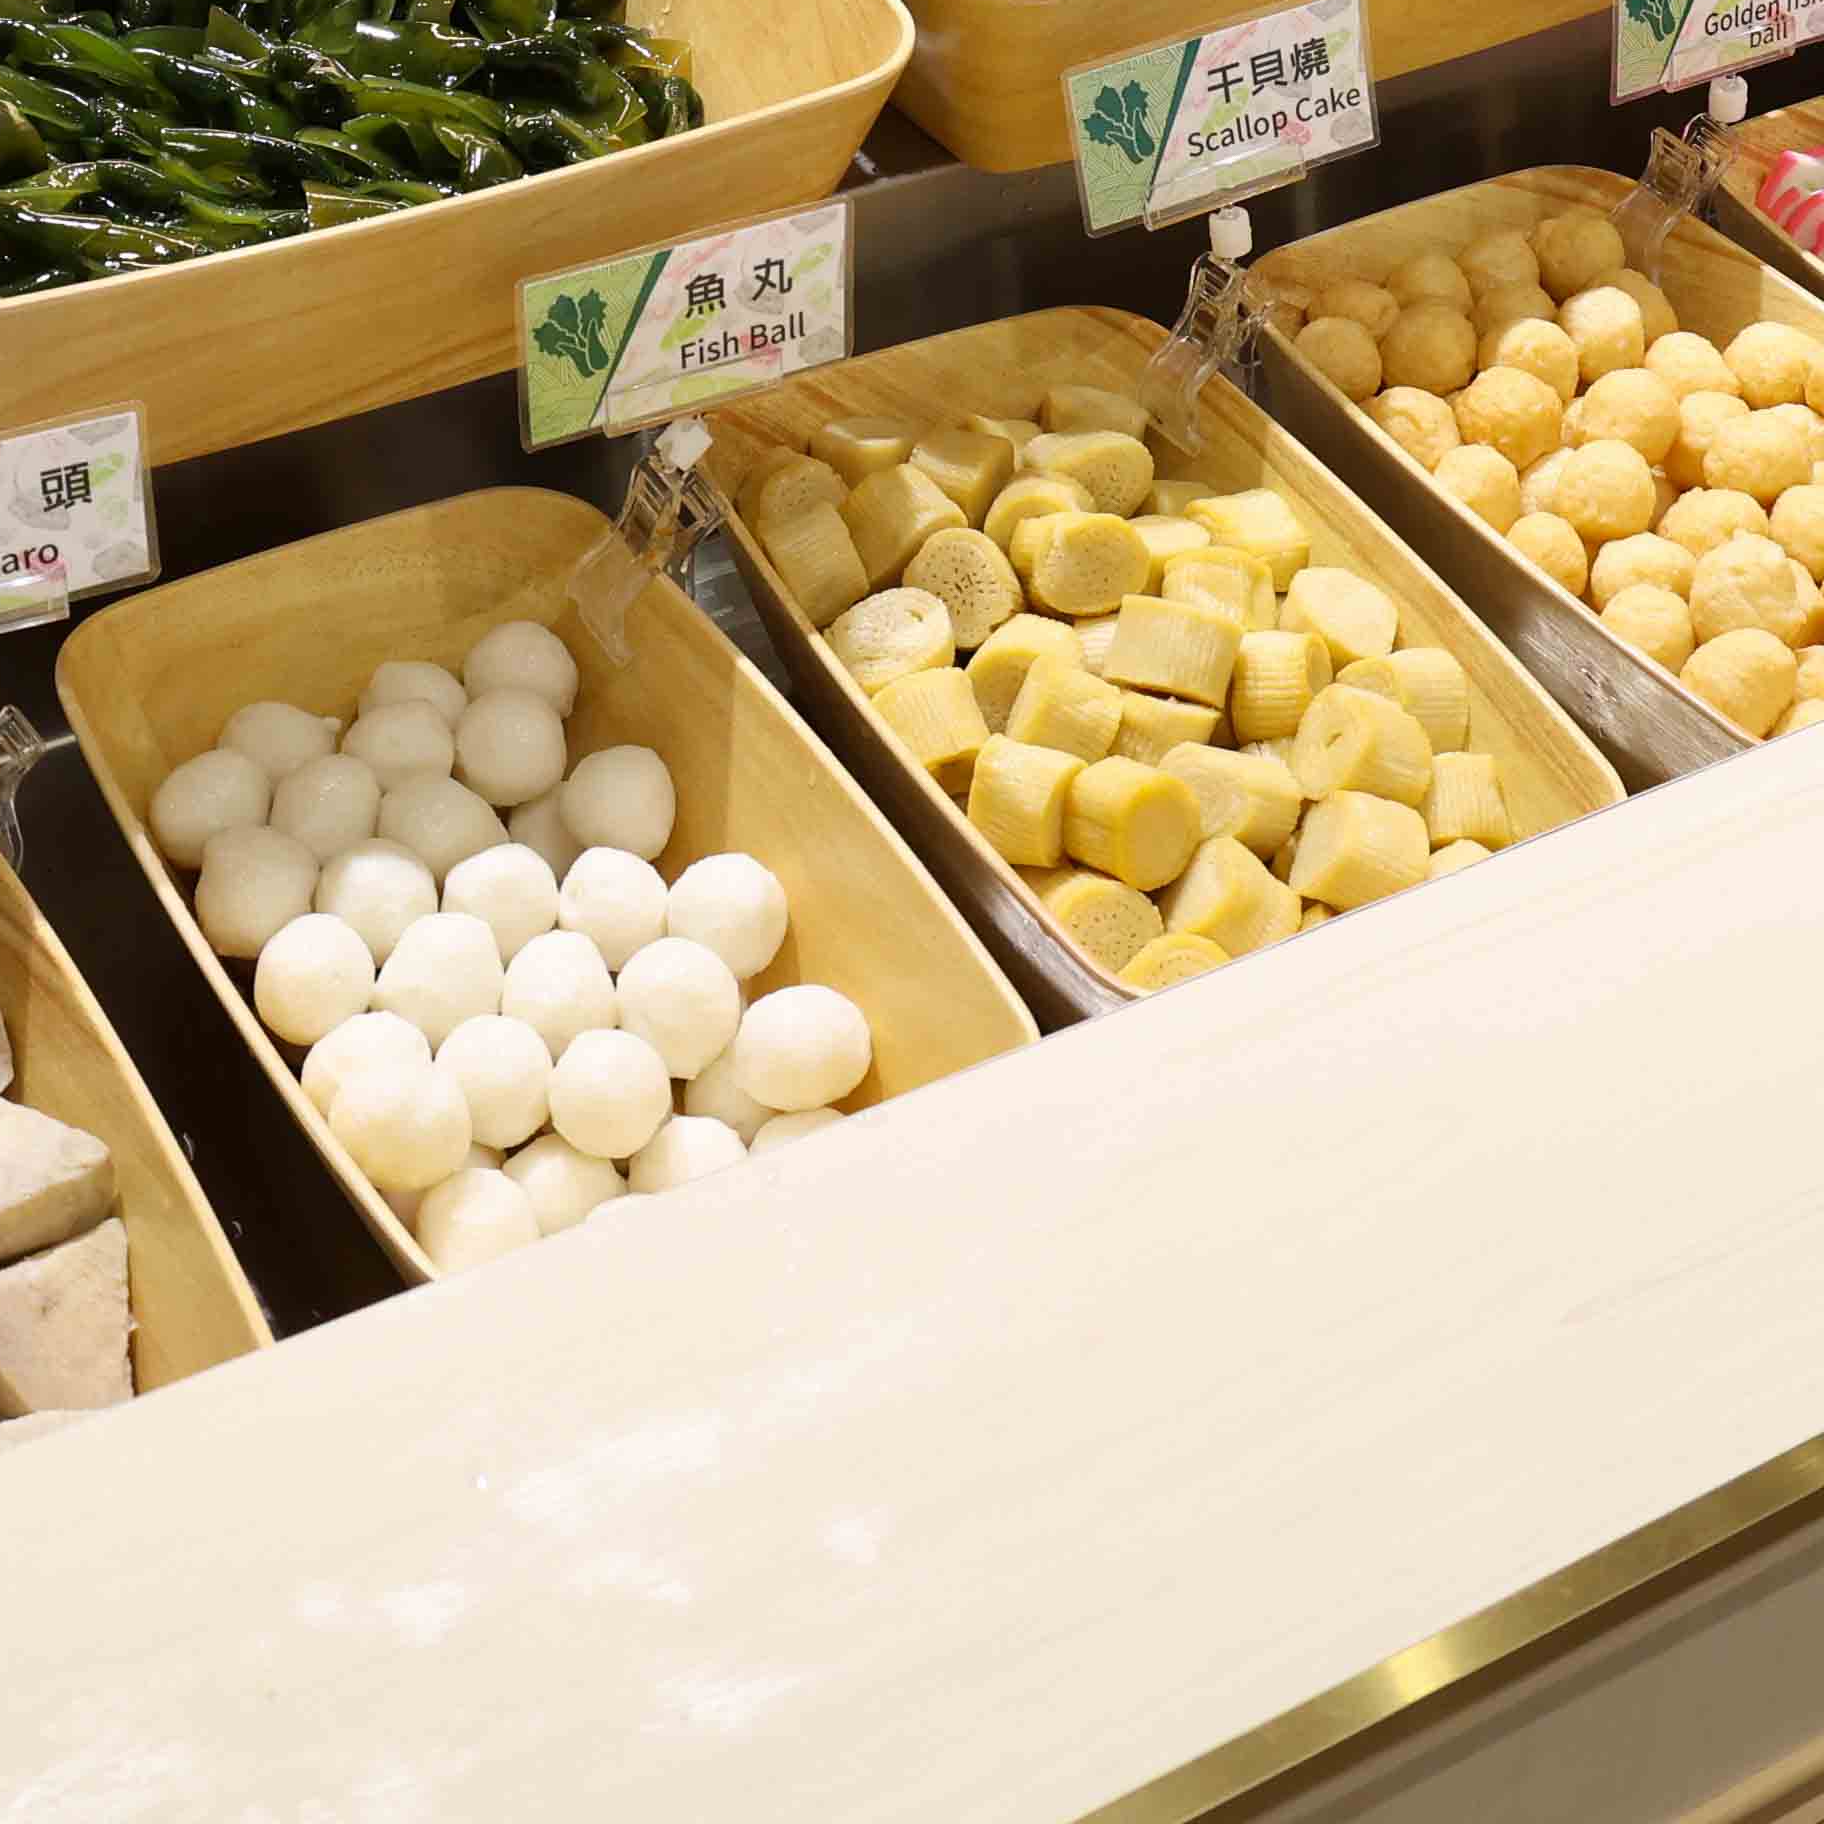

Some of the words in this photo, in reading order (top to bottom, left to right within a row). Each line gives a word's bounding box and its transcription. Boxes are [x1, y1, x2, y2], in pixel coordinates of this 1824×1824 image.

[1206, 36, 1331, 105] 干貝燒
[1187, 109, 1288, 159] Scallop
[1295, 85, 1361, 123] Cake
[684, 256, 794, 319] 魚丸
[680, 331, 740, 370] Fish
[749, 311, 806, 352] Ball
